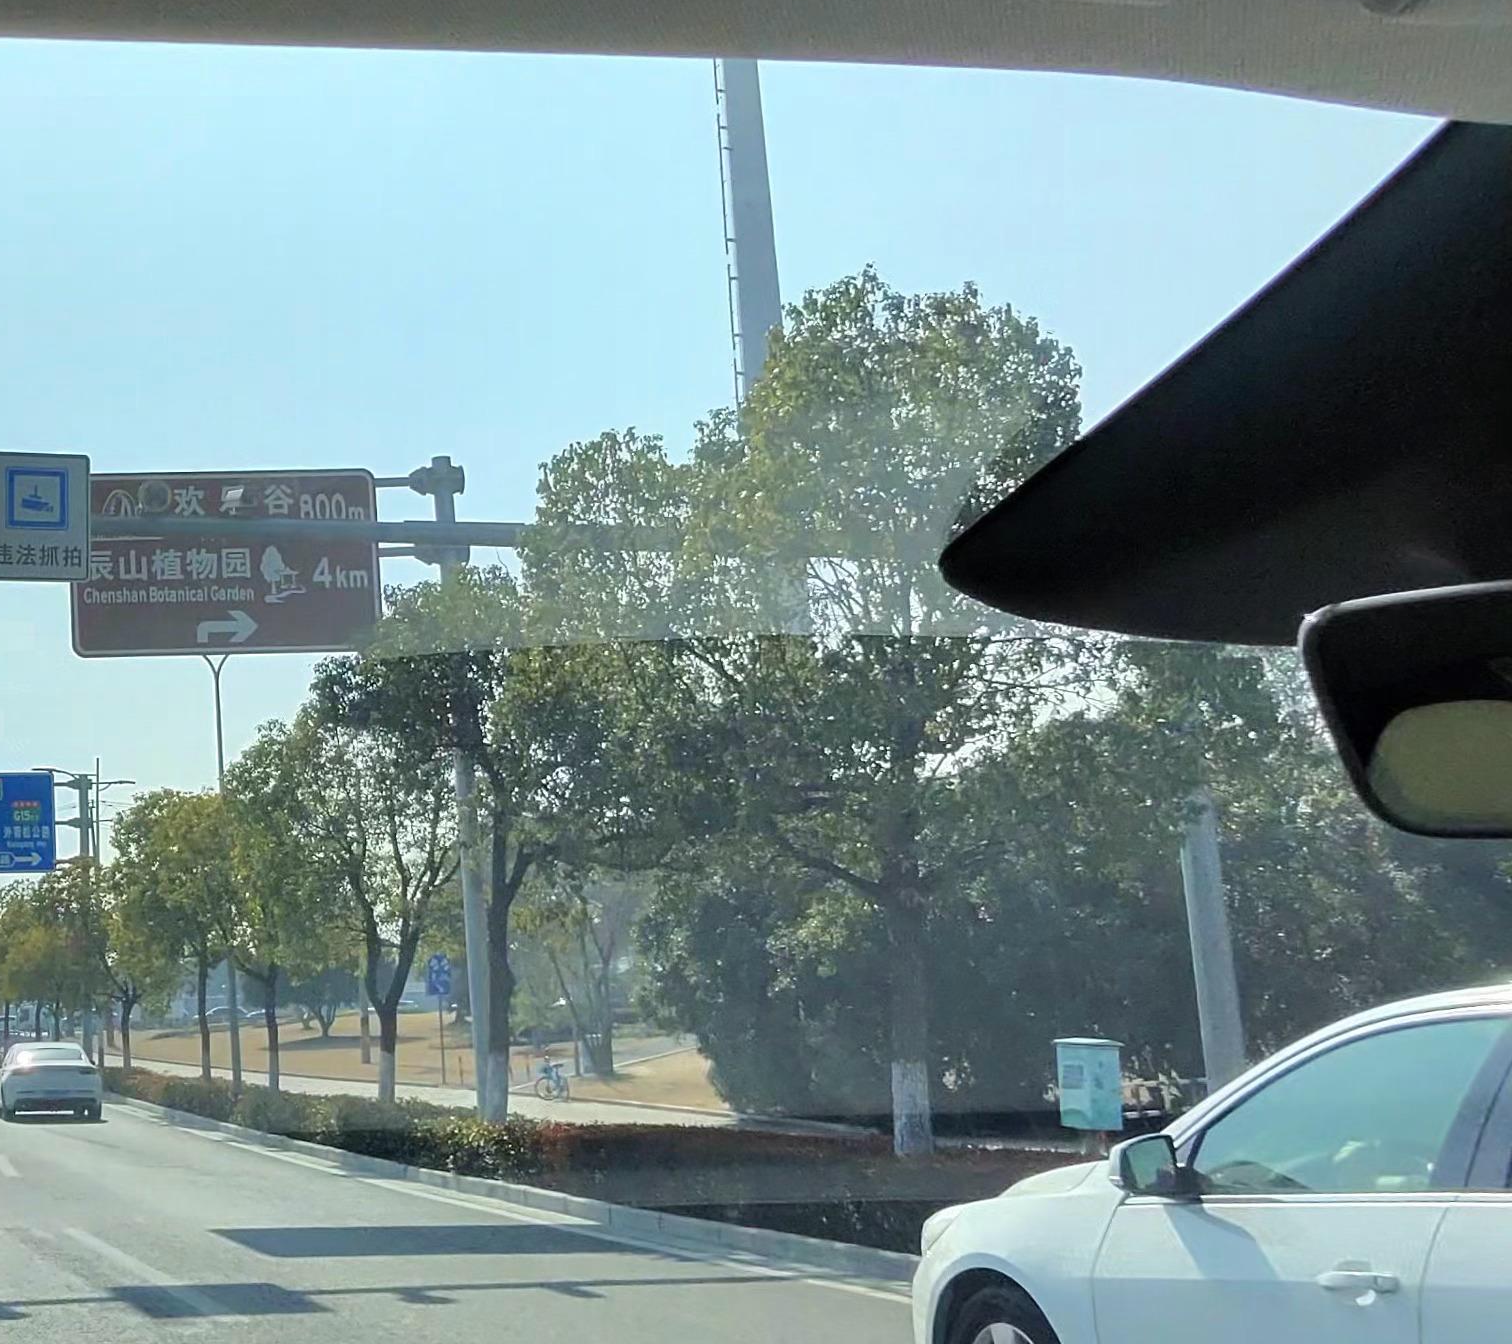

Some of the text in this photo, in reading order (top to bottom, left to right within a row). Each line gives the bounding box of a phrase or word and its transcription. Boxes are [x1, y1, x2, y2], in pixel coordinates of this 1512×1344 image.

[90, 548, 252, 581] 辰山植物园
[83, 586, 254, 604] Chenshan Botanical Garden
